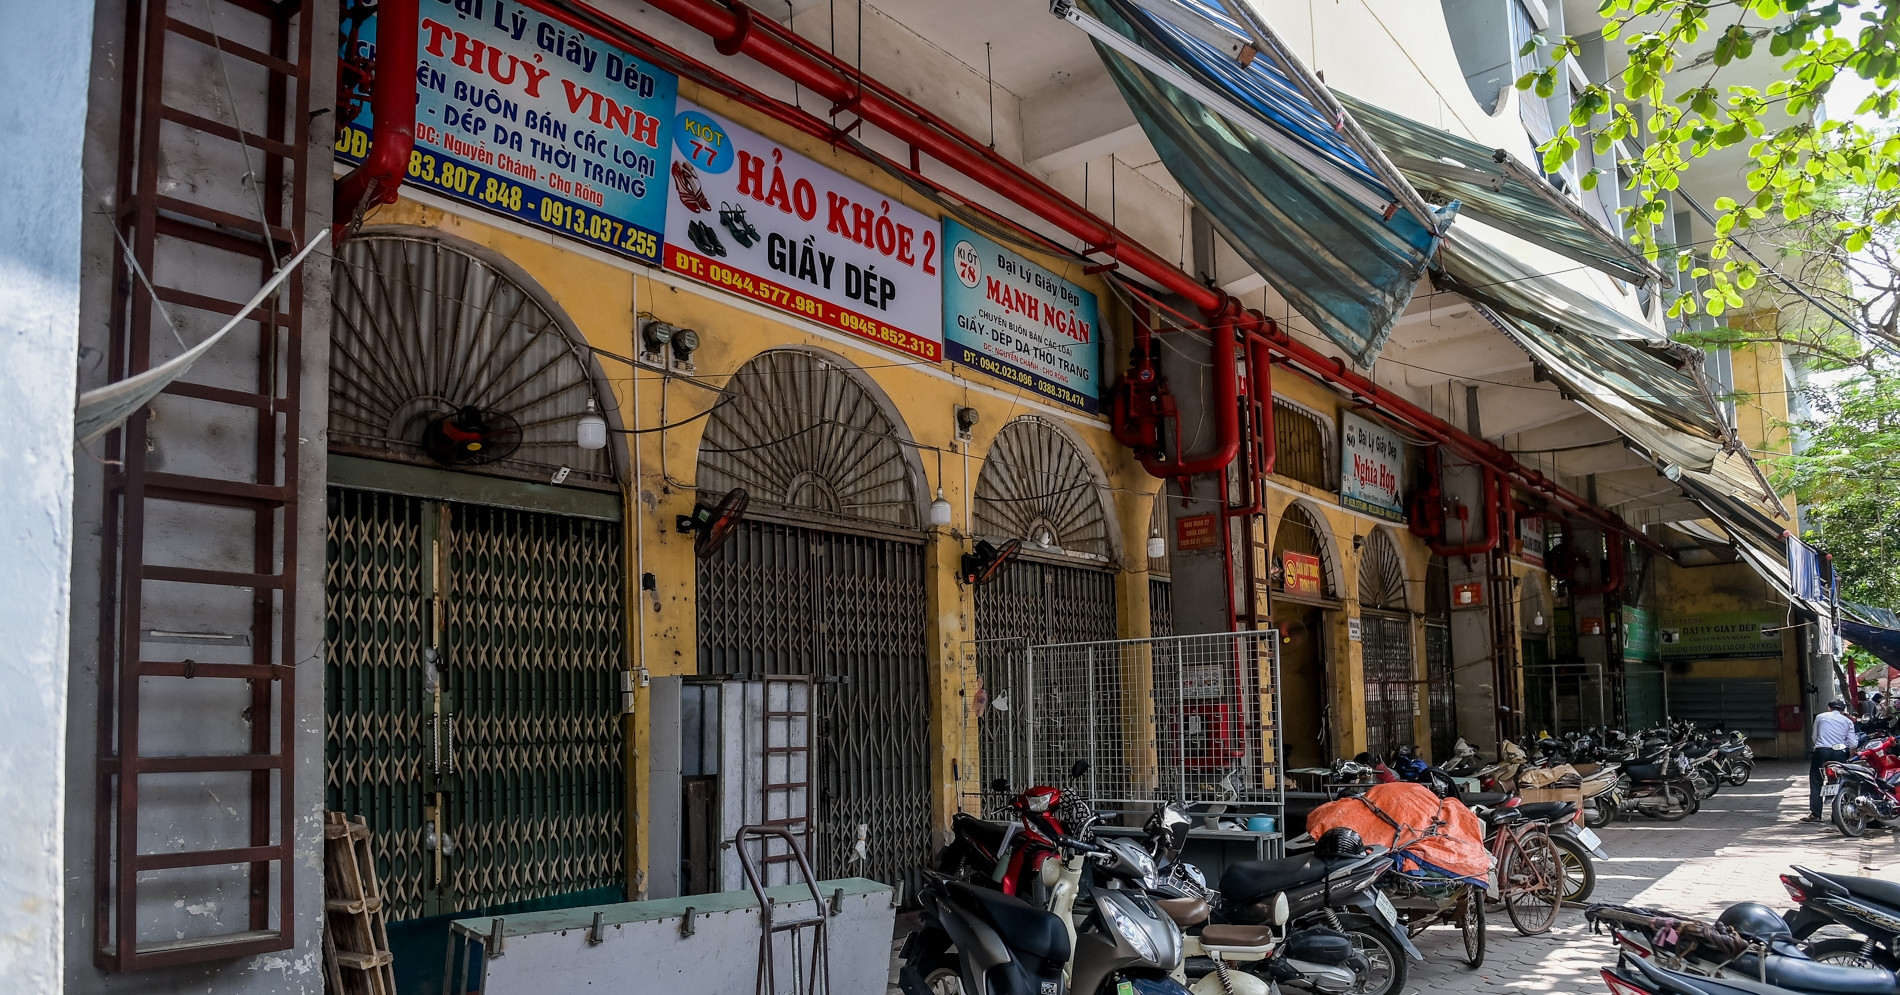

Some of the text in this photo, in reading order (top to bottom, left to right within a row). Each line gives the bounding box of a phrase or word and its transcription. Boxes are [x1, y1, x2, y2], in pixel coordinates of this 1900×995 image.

[421, 17, 660, 148] THUỶ VINH
[442, 0, 655, 98] ại Lý Giầy Dép
[416, 122, 441, 146] ĐC:
[443, 132, 494, 167] Nguyễn
[497, 153, 537, 182] Chánh
[549, 172, 572, 198] Chợ
[574, 180, 605, 208] Rồng
[443, 105, 487, 136] DÉP
[493, 124, 524, 153] DA
[530, 137, 577, 174] THỜI
[583, 159, 647, 199] TRANG
[453, 80, 519, 122] BUÔN
[525, 105, 566, 142] BÁN
[573, 128, 607, 158] CÁC
[613, 144, 656, 179] LOẠI
[690, 140, 718, 167] 77
[540, 197, 657, 259] 0913.037.255
[736, 148, 937, 276] HẢO KHỎE 2
[675, 252, 704, 276] ĐT:
[709, 264, 824, 318] 0944.577.981
[840, 311, 935, 358] 0945.852.313
[767, 232, 896, 312] GIẦY DÉP
[960, 261, 976, 283] 78
[986, 275, 1090, 345] MẠNH NGÂN
[997, 253, 1016, 276] Đại
[1020, 265, 1033, 284] Lý
[1061, 287, 1080, 307] Dép
[957, 314, 985, 336] GIẦY
[991, 329, 1013, 347] DÉP
[1015, 338, 1031, 356] DA
[1033, 346, 1056, 367] THỜI
[1058, 357, 1089, 380] TRANG
[1353, 453, 1378, 486] Nghĩa
